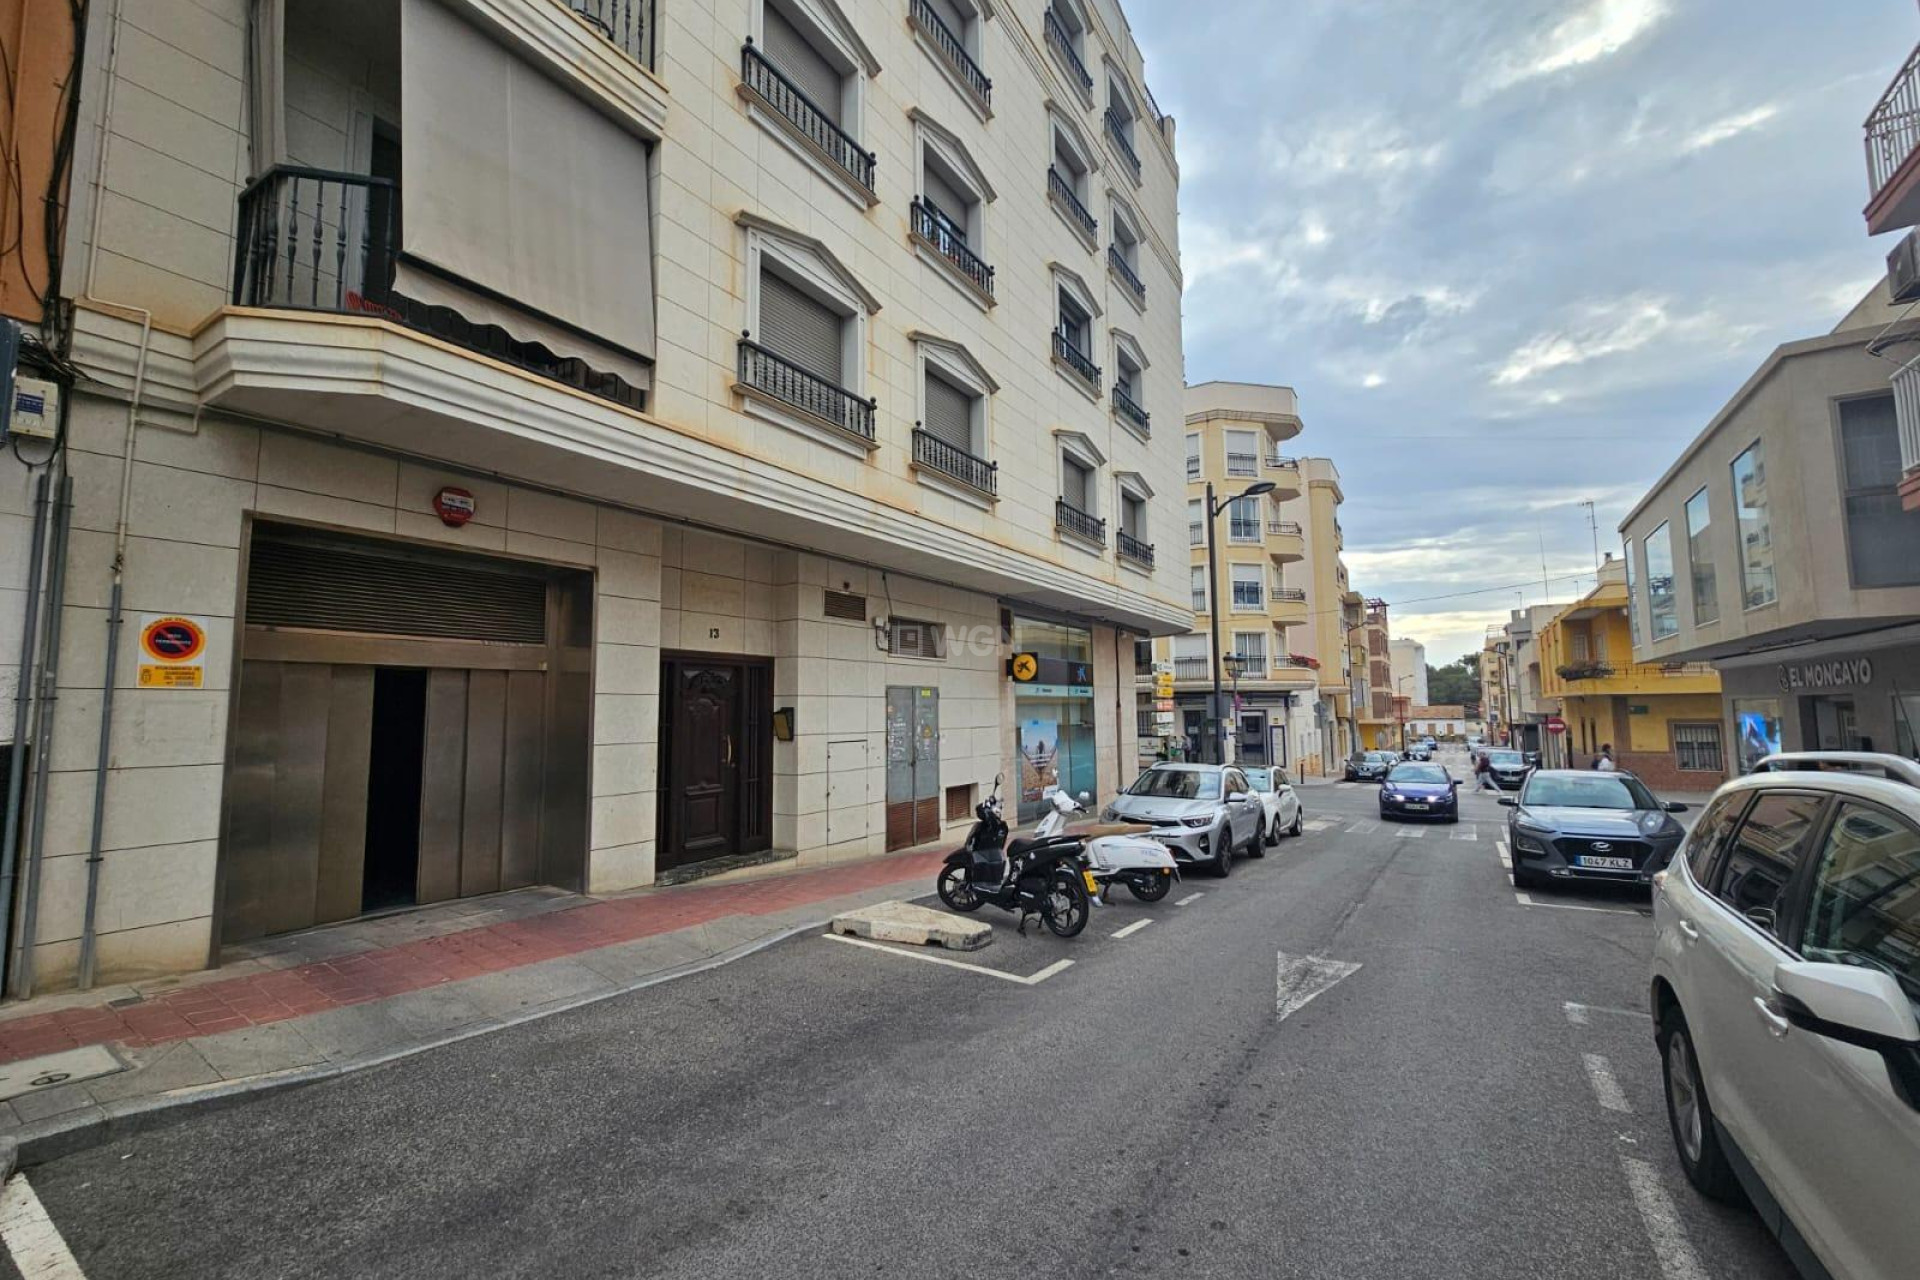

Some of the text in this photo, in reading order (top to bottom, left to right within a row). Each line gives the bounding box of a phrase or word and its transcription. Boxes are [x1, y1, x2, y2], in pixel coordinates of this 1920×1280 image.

[709, 628, 720, 639] 13
[1789, 658, 1873, 688] EL MONCAYO
[1583, 856, 1607, 867] 1047
